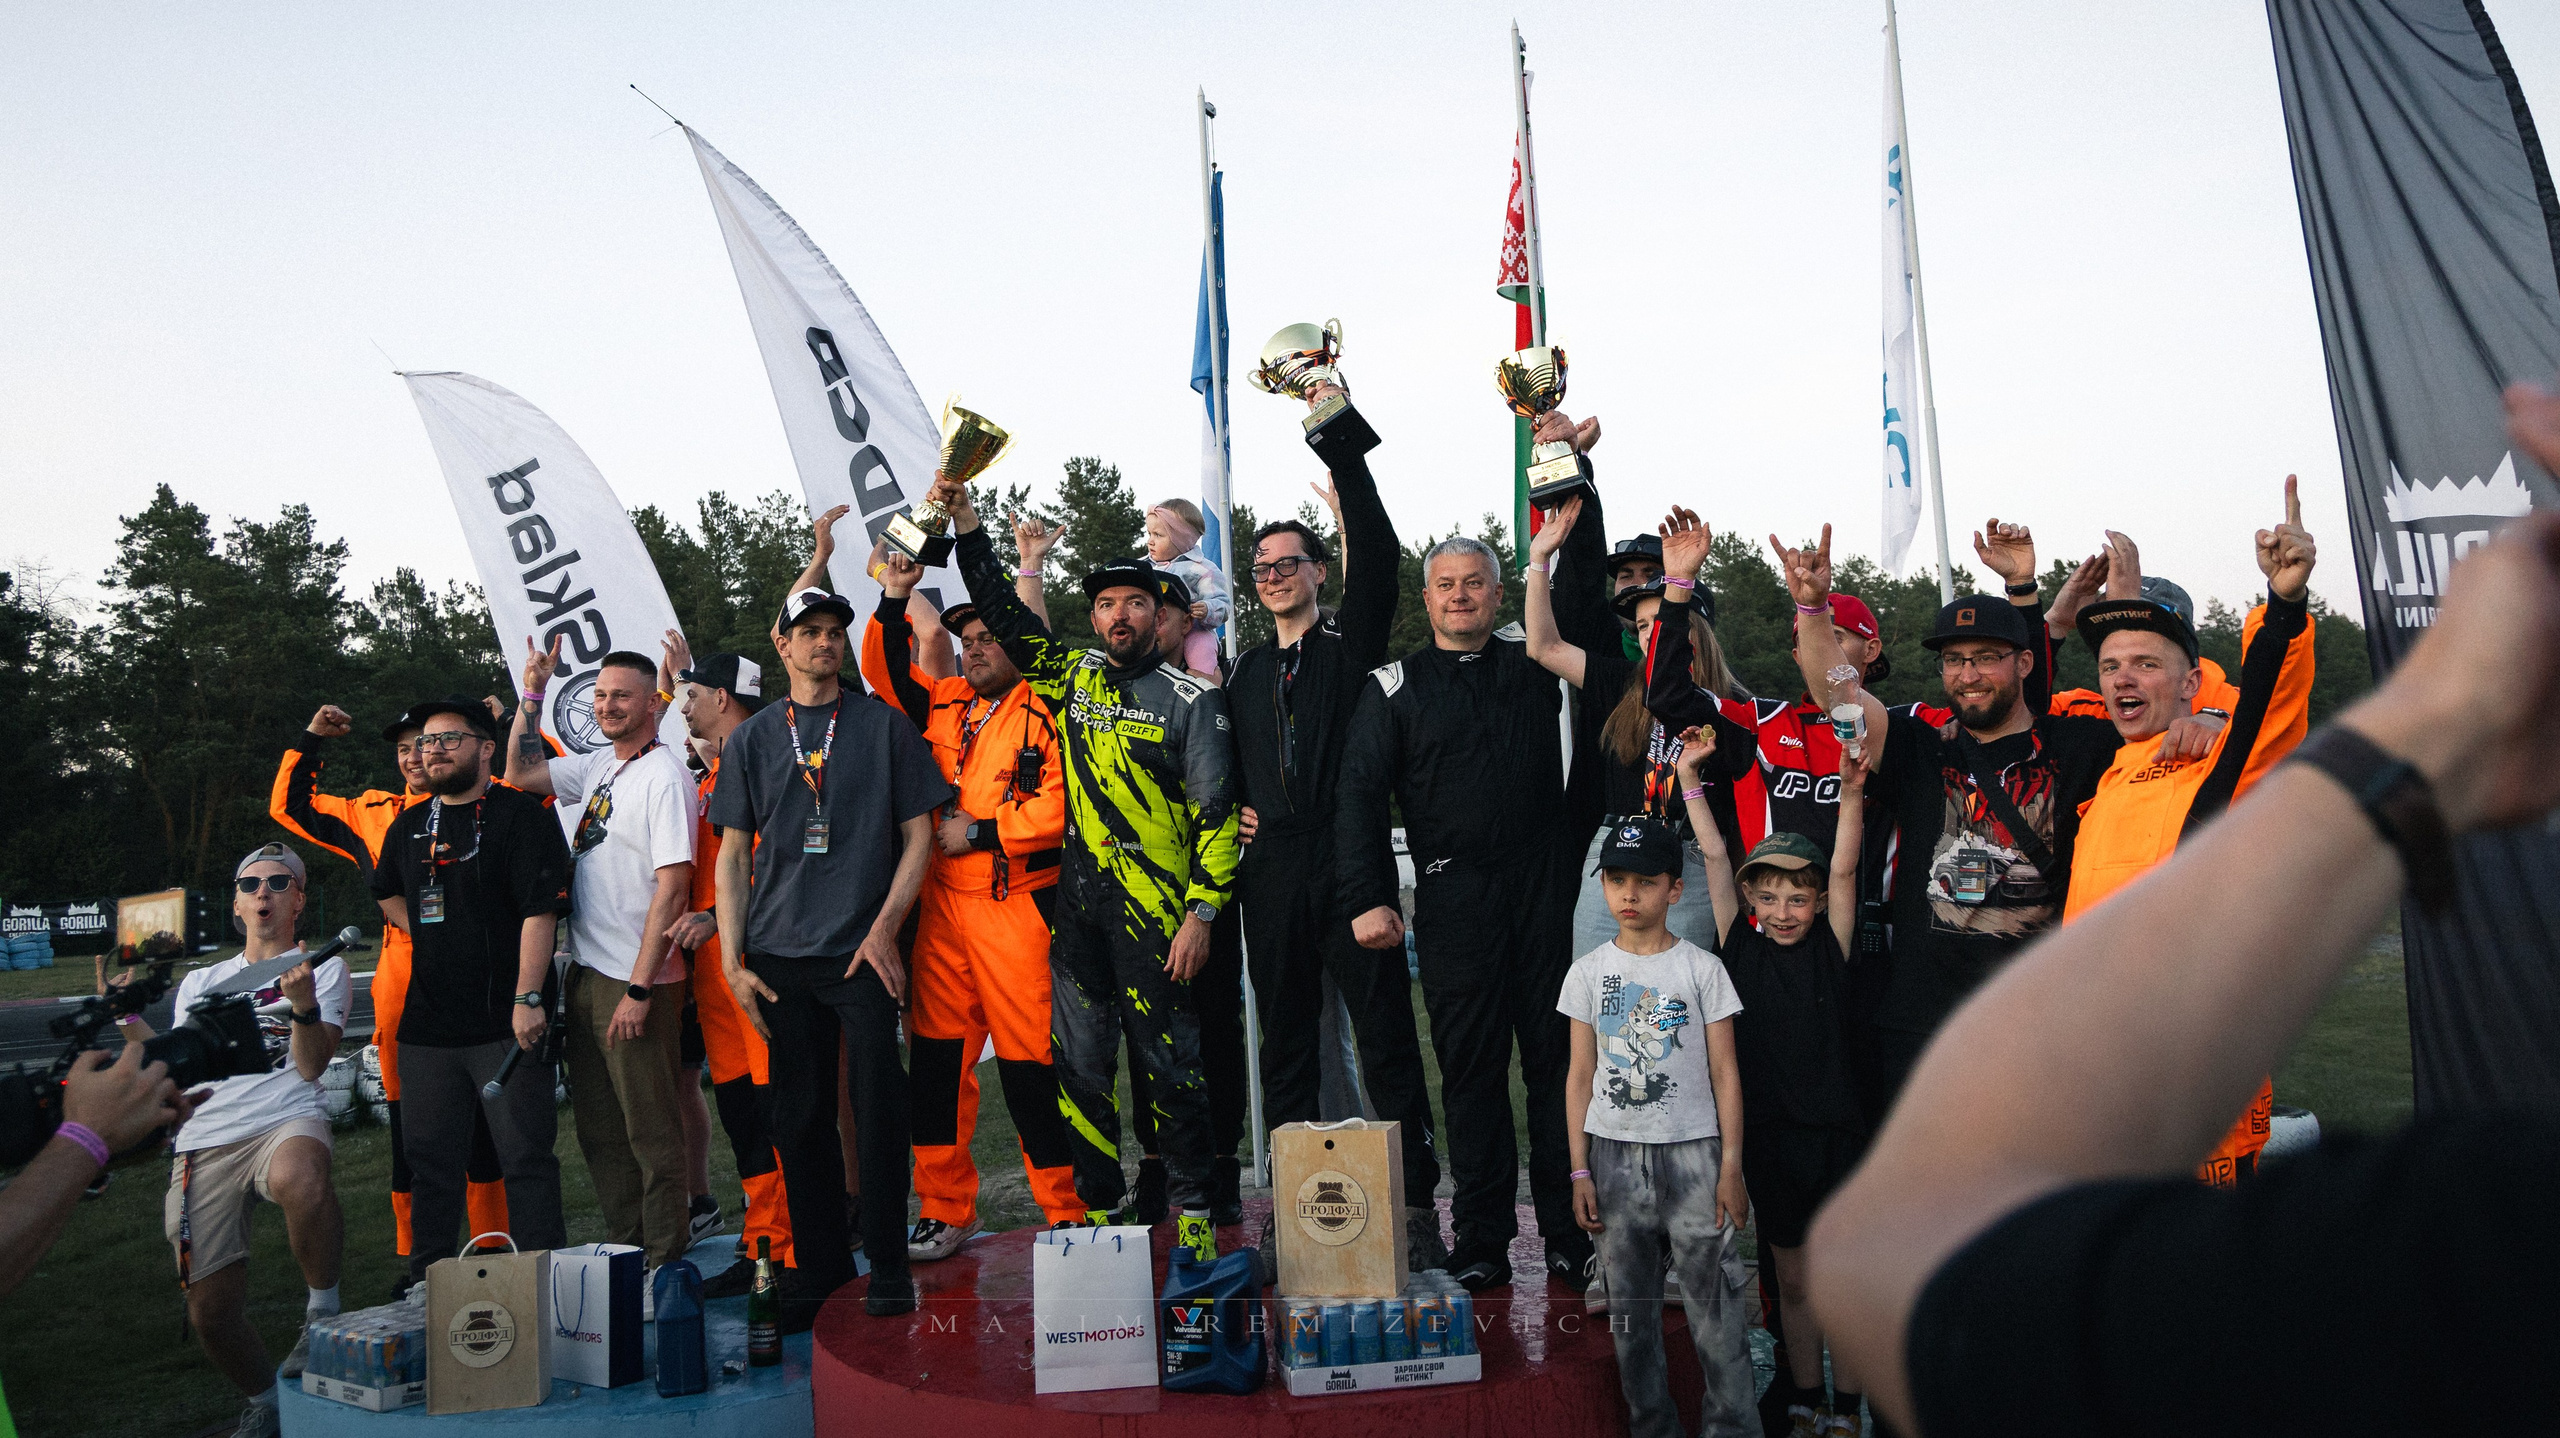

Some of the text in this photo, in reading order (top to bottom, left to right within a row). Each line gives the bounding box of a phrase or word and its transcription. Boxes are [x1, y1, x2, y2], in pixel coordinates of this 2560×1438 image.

[1178, 683, 1197, 698] OMP
[1121, 723, 1158, 738] DRIFT
[1774, 772, 1811, 799] JP
[2, 917, 51, 932] GORILLA
[60, 914, 108, 930] GORILLA
[1302, 1205, 1361, 1217] ГРОДФУД
[453, 1328, 510, 1343] ГРОДФУД
[1046, 1325, 1145, 1344] WESTMOTORS
[1174, 1326, 1203, 1334] Valvoline
[1167, 1351, 1183, 1361] 5W-30
[1394, 1362, 1445, 1374] ЗАРЯДИ СВОЙ
[1325, 1378, 1358, 1391] GORILLA
[1394, 1372, 1434, 1383] ИНСТИНКТ
